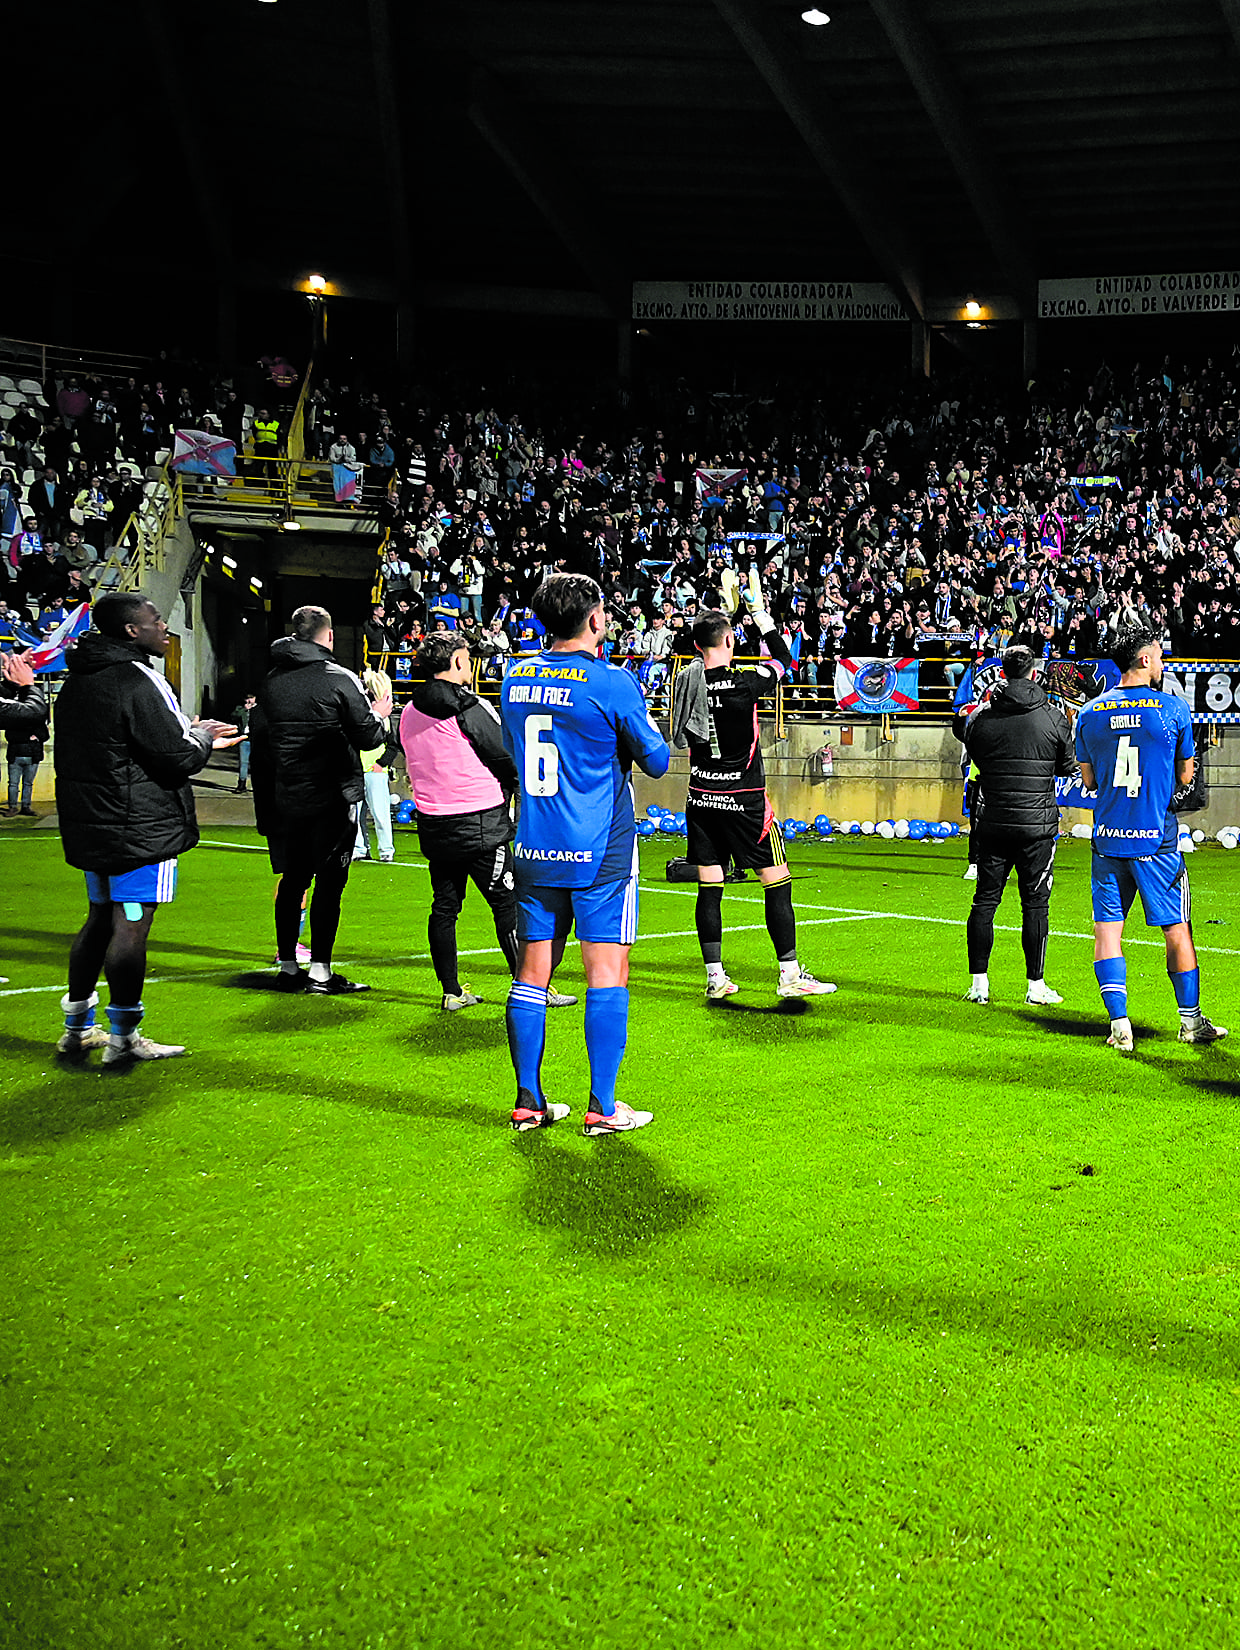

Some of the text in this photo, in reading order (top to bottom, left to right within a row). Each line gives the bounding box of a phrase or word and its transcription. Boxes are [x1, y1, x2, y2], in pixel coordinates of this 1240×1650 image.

[688, 283, 853, 299] ENTIDAD COLABORADORA
[1095, 276, 1151, 294] ENTIDAD
[636, 303, 906, 319] EXCMO. AYTO. DE SANTOVENIA DE LA VALDONCINA
[1041, 299, 1091, 317] EXCMO.
[1097, 297, 1136, 315] AYTO.
[1141, 296, 1157, 312] DE
[1162, 293, 1228, 311] VALVERDE
[509, 685, 574, 706] BORJA FDEZ.
[1093, 700, 1117, 712] CAJA
[1110, 714, 1142, 729] SIBILLE
[525, 714, 559, 797] 6
[1113, 736, 1142, 798] 4
[692, 799, 744, 812] PONFERRADA
[1106, 829, 1159, 839] VALCARCE
[524, 848, 592, 863] VALCARCE
